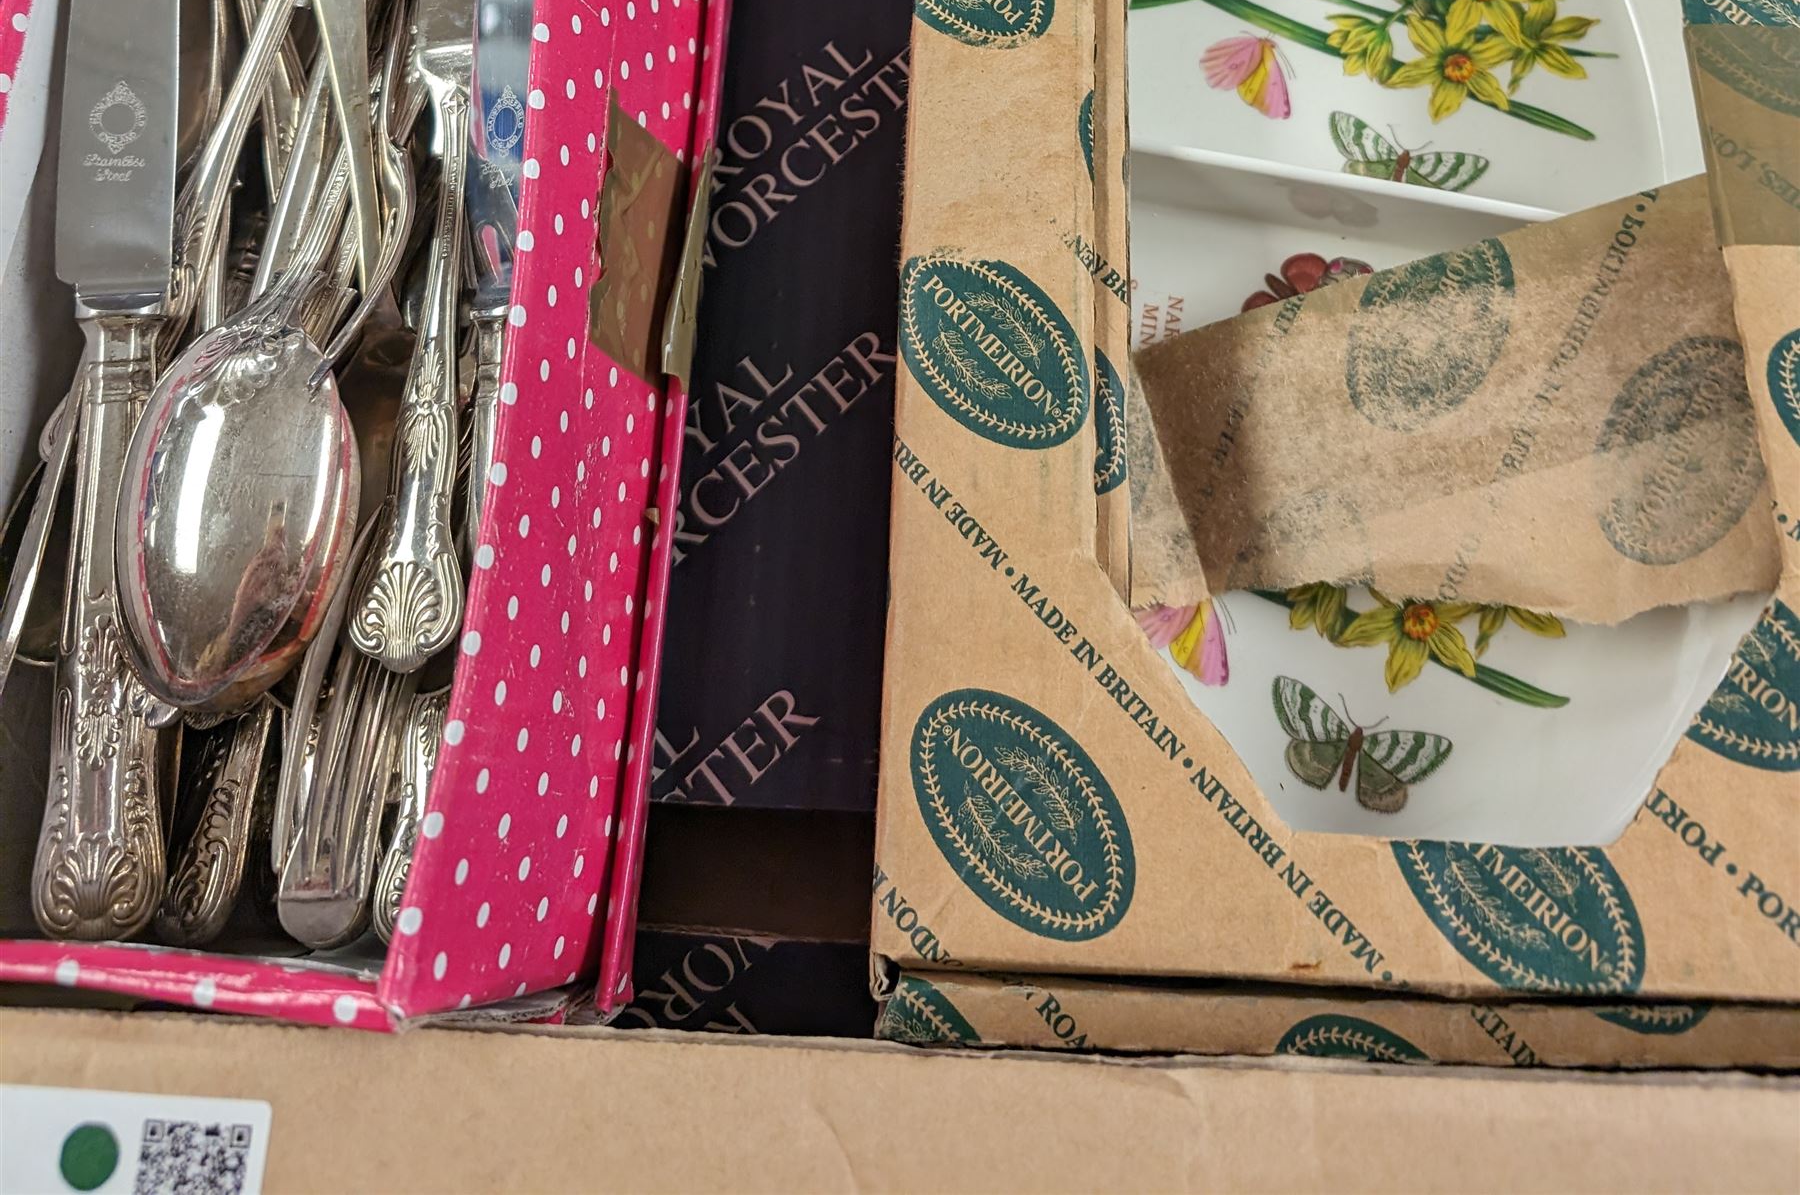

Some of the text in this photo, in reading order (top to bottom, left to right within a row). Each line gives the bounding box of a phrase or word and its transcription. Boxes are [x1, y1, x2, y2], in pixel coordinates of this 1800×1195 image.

[921, 274, 1062, 418] PORTMEIRION
[921, 476, 954, 510] IN
[943, 500, 1010, 571] MADE
[1010, 571, 1187, 761] MADE IN BRITAIN
[942, 727, 1100, 903] PORTMEIRION
[1189, 765, 1385, 974] MADE IN BRITAIN
